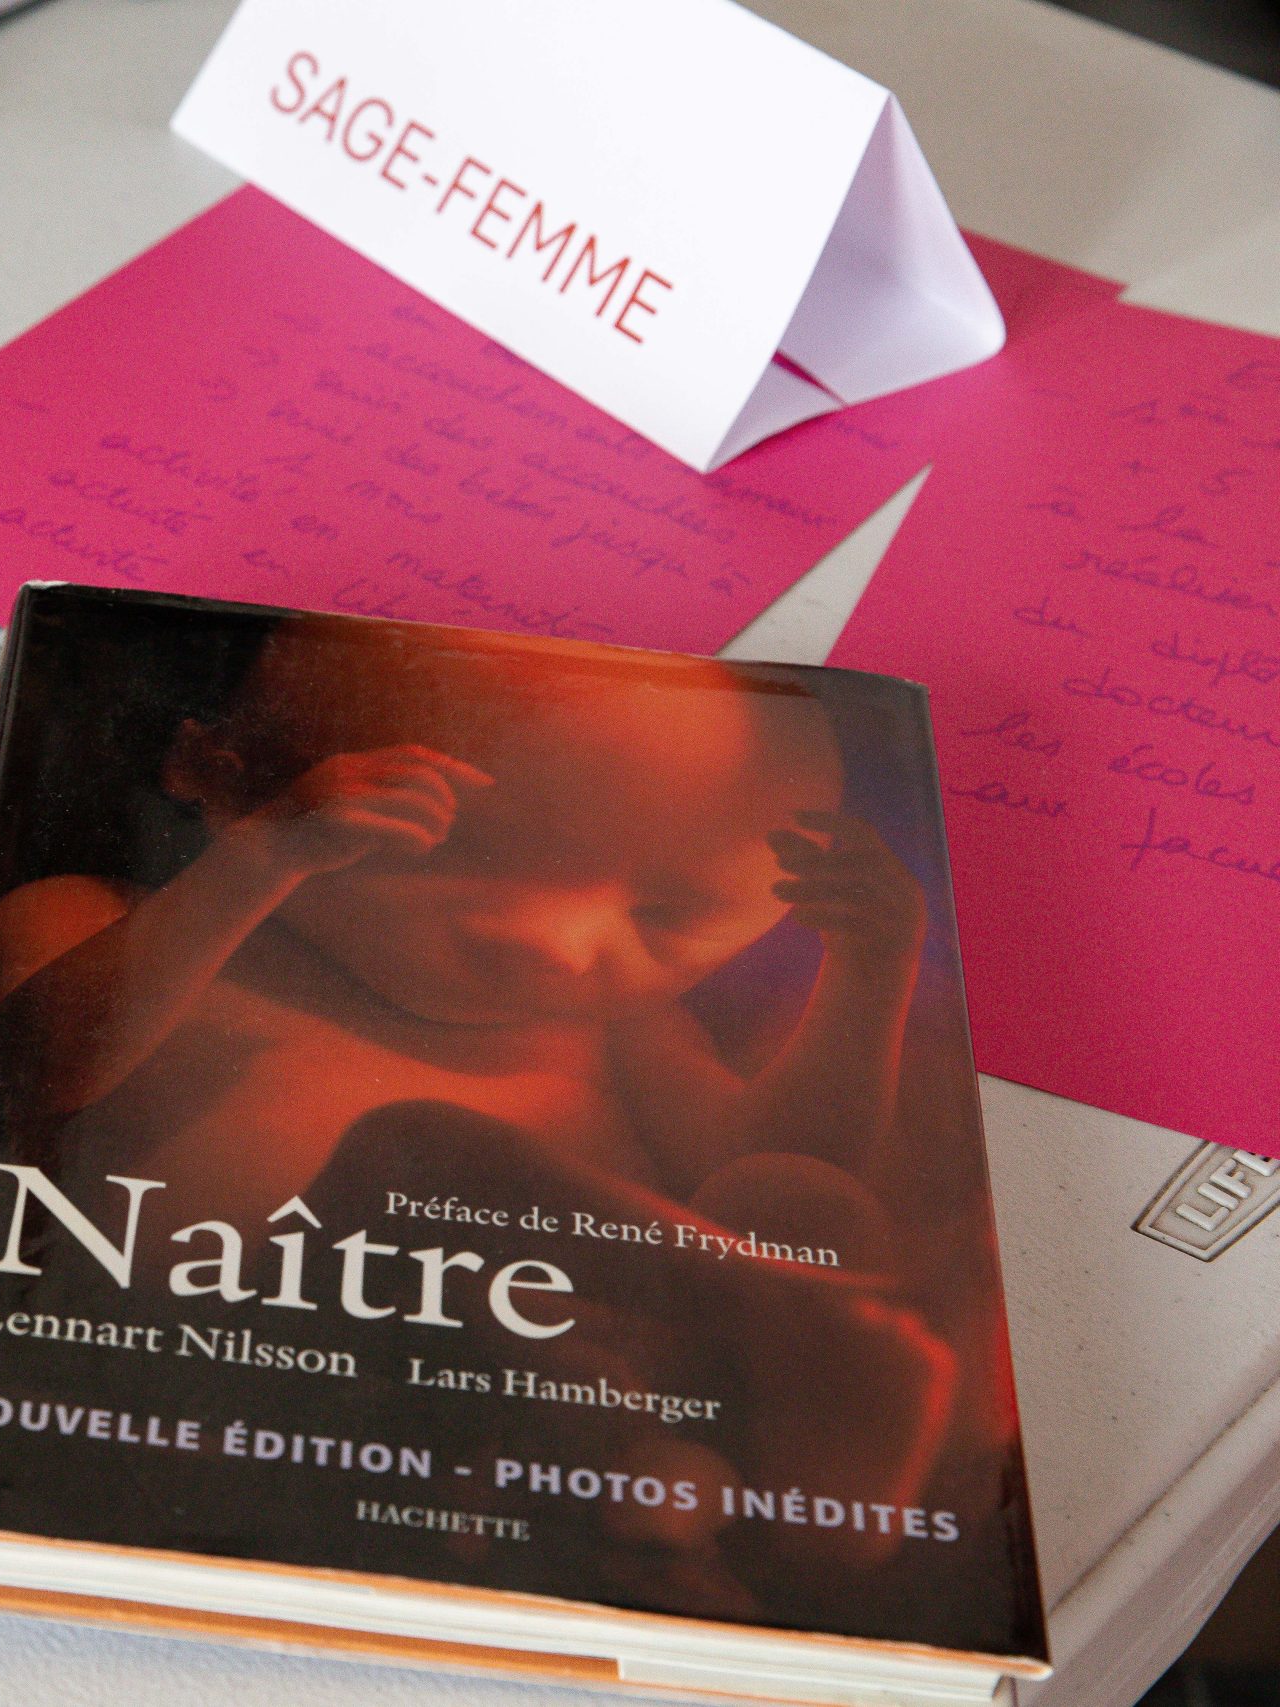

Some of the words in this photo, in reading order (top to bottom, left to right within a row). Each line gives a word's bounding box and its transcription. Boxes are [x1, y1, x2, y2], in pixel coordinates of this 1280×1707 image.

[270, 50, 674, 345] SAGE-FEMME
[961, 710, 1063, 758] les
[1107, 742, 1256, 805] écoles
[385, 1192, 509, 1229] Préface
[519, 1205, 560, 1233] de
[570, 1211, 663, 1246] René
[673, 1223, 841, 1268] Frydman
[175, 1323, 358, 1379] Nilsson
[407, 1358, 492, 1394] Lars
[502, 1368, 721, 1424] Hamberger
[222, 1420, 433, 1479] ÉDITION
[494, 1459, 699, 1511] PHOTOS
[721, 1487, 960, 1543] INÉDITES
[356, 1501, 531, 1542] HACHETTE
